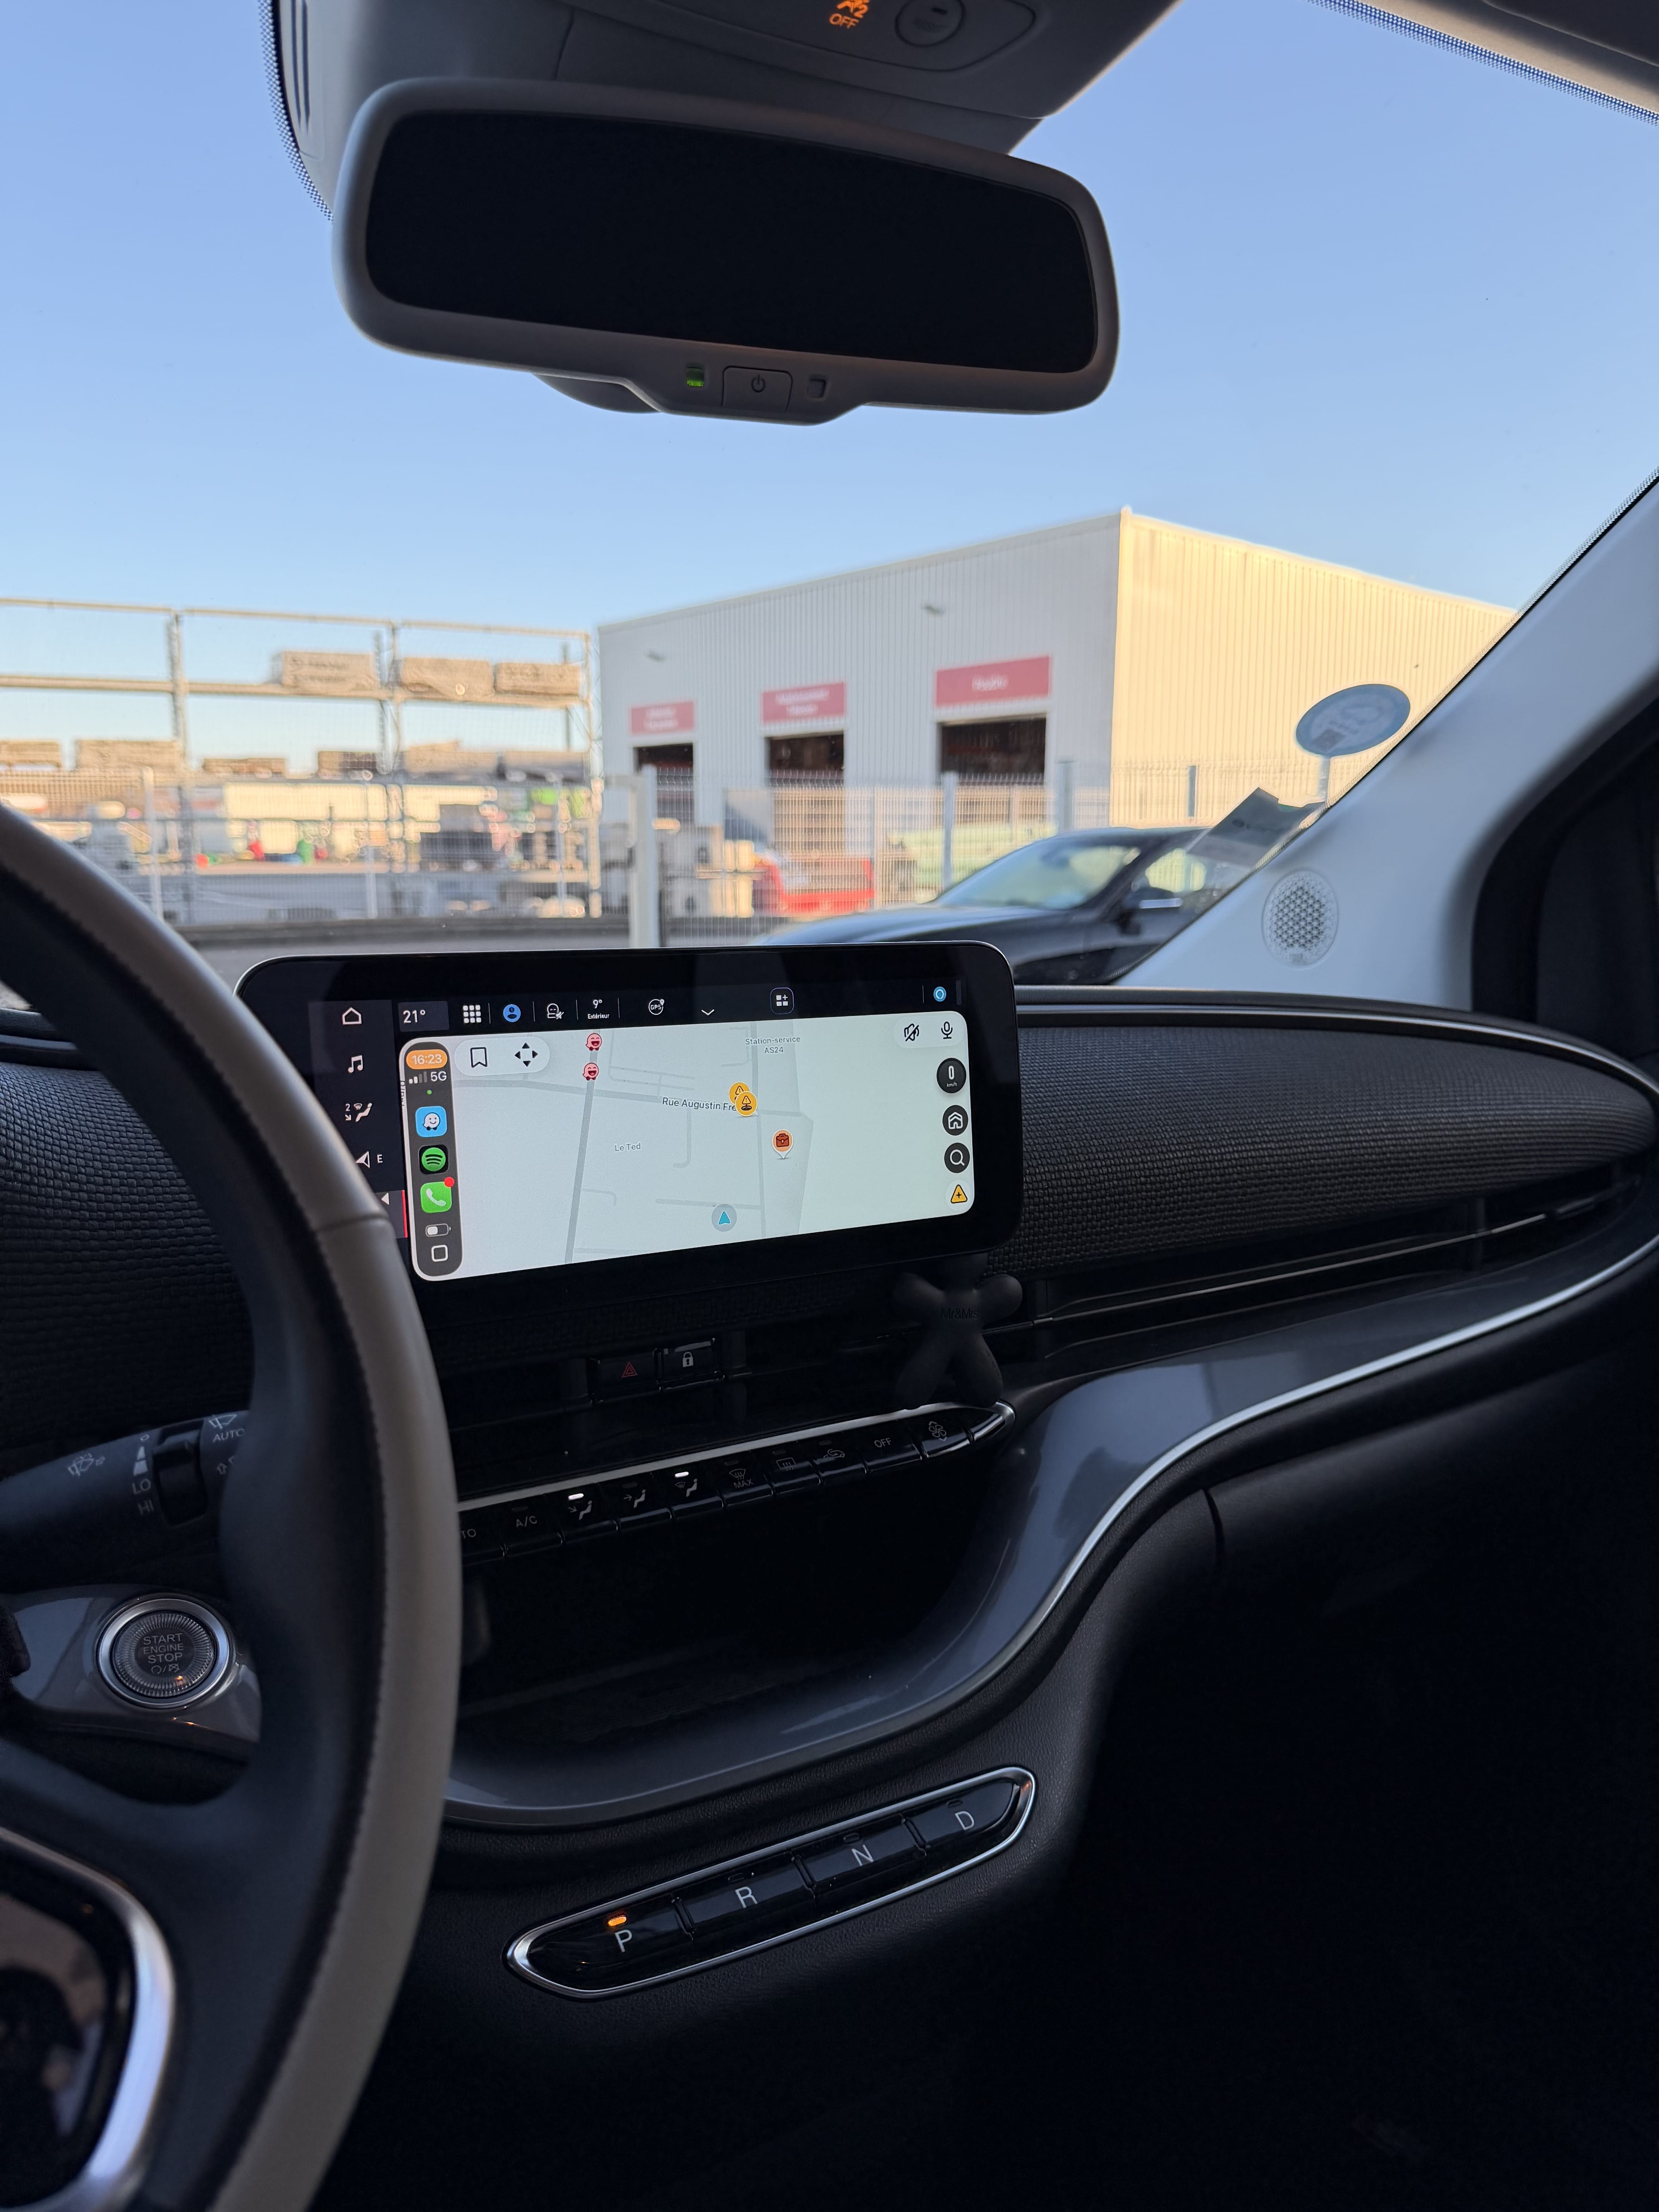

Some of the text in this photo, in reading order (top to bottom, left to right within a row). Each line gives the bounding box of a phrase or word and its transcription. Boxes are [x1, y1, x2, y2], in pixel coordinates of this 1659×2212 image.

[829, 13, 859, 29] OFF
[403, 1010, 426, 1024] 21°
[745, 1037, 801, 1045] Station-service
[412, 1053, 442, 1065] 16:23
[430, 1071, 447, 1082] 5G
[948, 1065, 955, 1080] 0
[345, 1103, 350, 1111] 2
[662, 1097, 736, 1112] Rue Augustin Fre
[377, 1154, 383, 1163] E
[940, 1307, 979, 1319] Mr&Mrs
[212, 1427, 245, 1443] AUTO
[874, 1437, 891, 1448] OFF
[132, 1479, 151, 1495] LO
[733, 1478, 754, 1489] MAX
[137, 1499, 155, 1515] HI
[516, 1516, 538, 1528] A/C
[461, 1528, 476, 1539] TO
[143, 1633, 183, 1645] START
[143, 1643, 184, 1654] ENGINE
[148, 1652, 183, 1664] STOP
[955, 1811, 975, 1831] D
[852, 1845, 874, 1867] N
[735, 1886, 758, 1908] R
[613, 1930, 632, 1953] P
